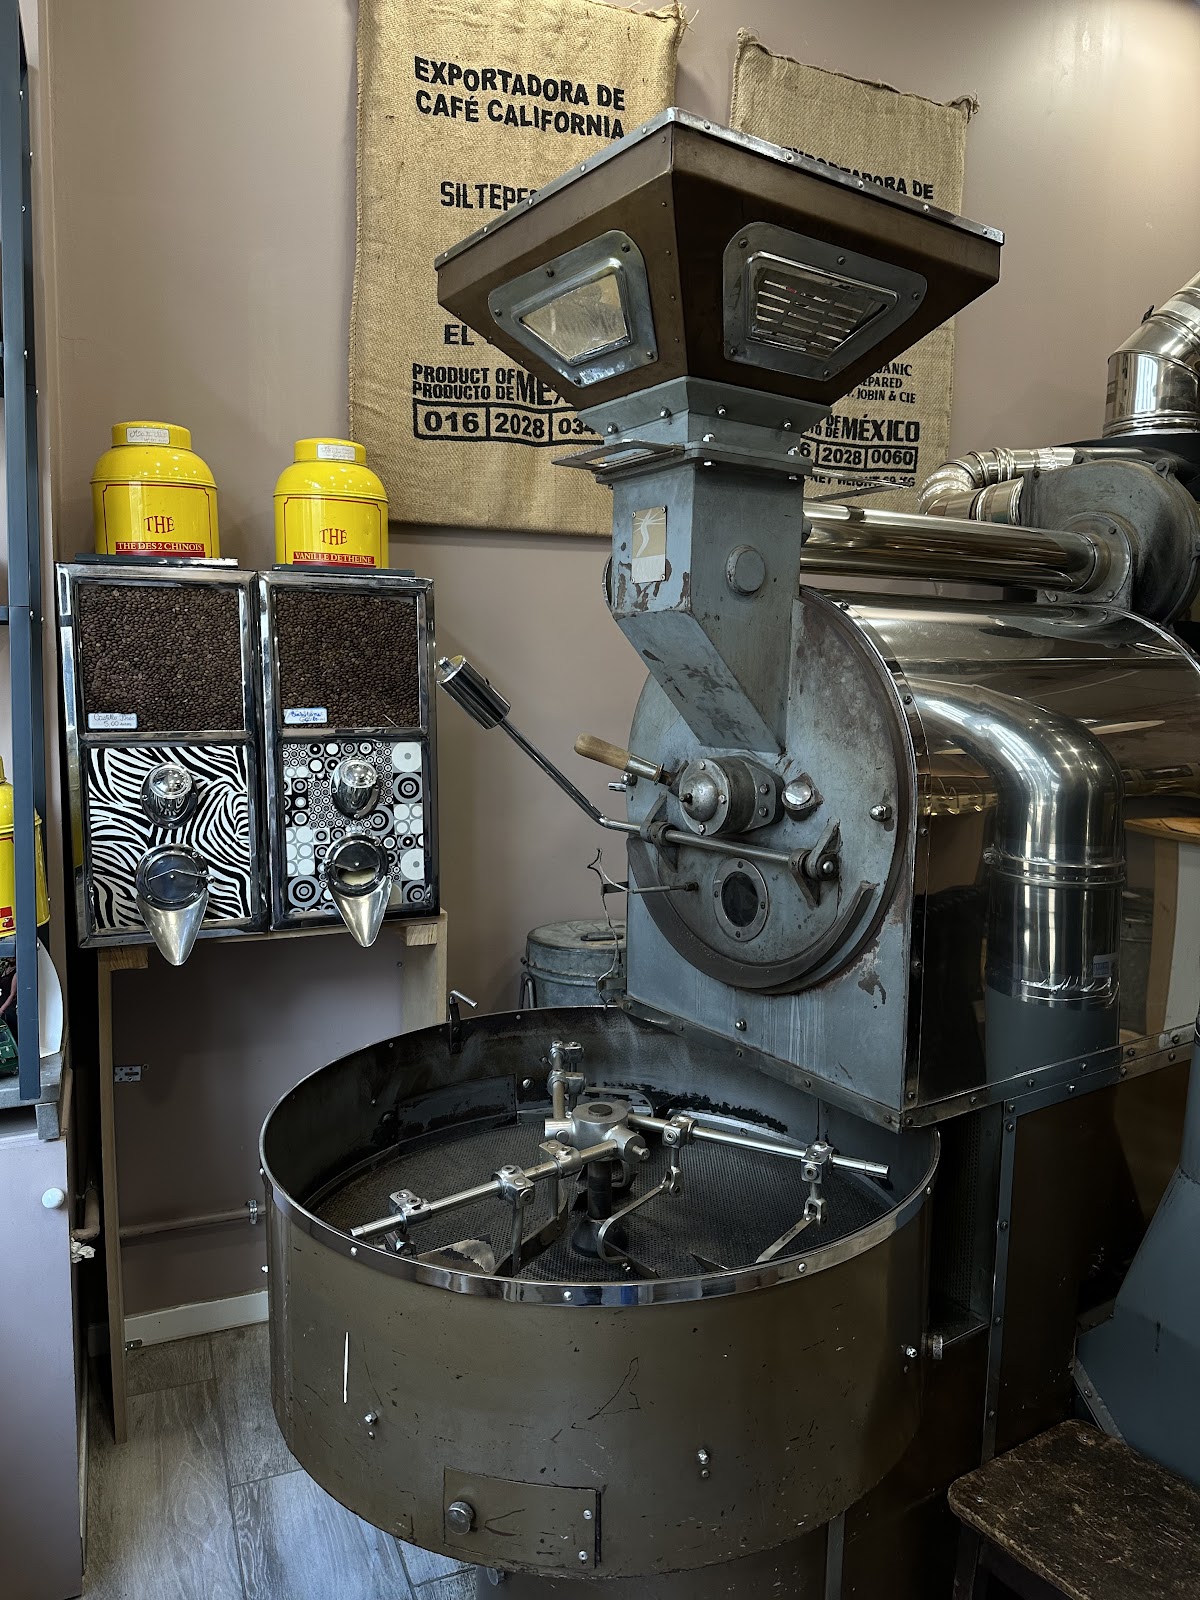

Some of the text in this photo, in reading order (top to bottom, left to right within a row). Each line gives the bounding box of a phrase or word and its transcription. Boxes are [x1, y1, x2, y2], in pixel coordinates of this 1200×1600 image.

[414, 55, 626, 111] EXPORTADORA DE
[415, 90, 625, 140] CAFÉ CALIFORNIA
[440, 181, 538, 211] SILTEPE
[912, 179, 934, 200] DE
[443, 324, 475, 346] EL
[412, 363, 491, 385] PRODUCT
[495, 367, 516, 385] OF
[860, 376, 903, 389] EPARED
[412, 381, 515, 401] PRODUCTO DE
[857, 388, 886, 401] JOBIN
[888, 390, 897, 402] &
[899, 391, 917, 404] CIE
[424, 411, 480, 434] 016
[494, 413, 545, 439] 2028
[841, 414, 920, 443] MÉXICO
[825, 427, 840, 439] DE
[822, 447, 863, 466] 2028
[871, 449, 914, 466] 0060
[144, 515, 176, 534] THE
[117, 542, 203, 551] THE DES 2 CHINOIS
[320, 527, 348, 546] THE
[295, 552, 330, 561] VANILLE
